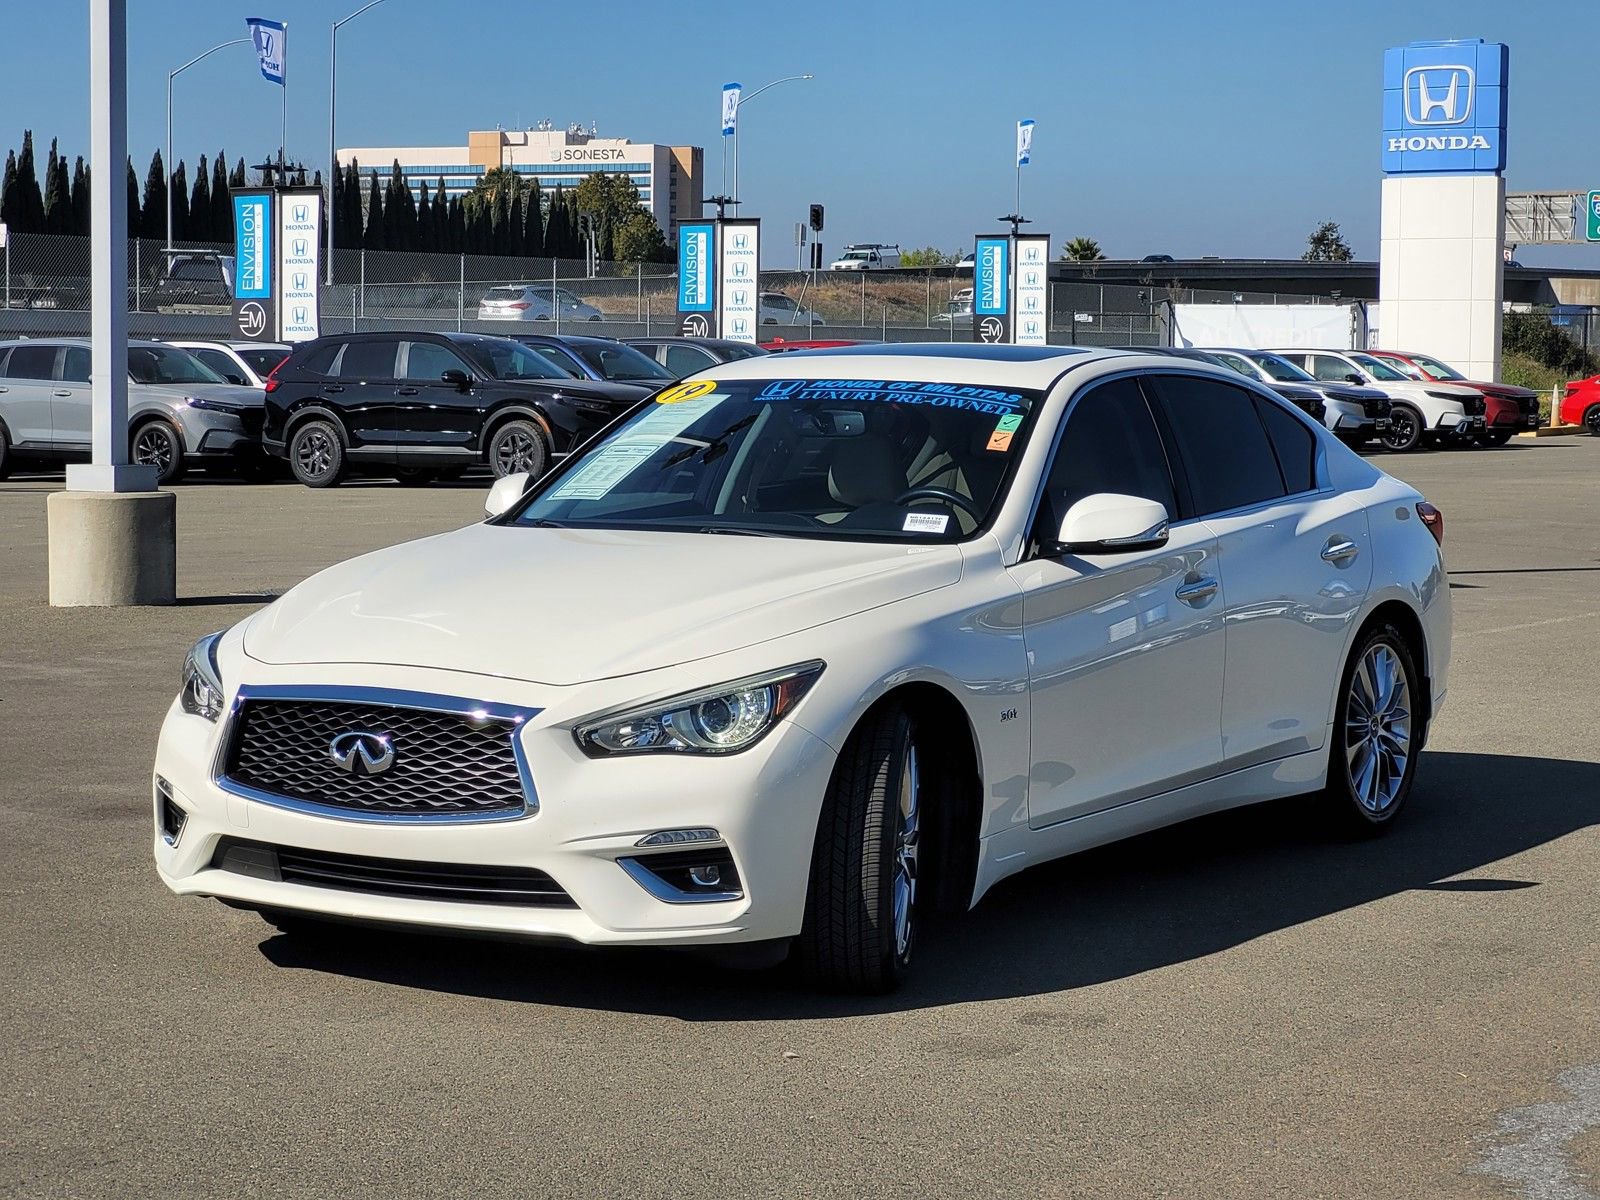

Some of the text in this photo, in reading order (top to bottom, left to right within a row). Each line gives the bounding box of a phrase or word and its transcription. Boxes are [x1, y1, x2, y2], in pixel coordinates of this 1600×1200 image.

[564, 149, 625, 160] SONESTA
[1388, 134, 1490, 152] HONDA
[242, 204, 256, 290] ENVISION
[685, 232, 698, 304] ENVISION
[982, 246, 994, 309] ENVISION
[662, 384, 708, 400] 19
[809, 380, 1023, 402] HONDA OF MILPITAS
[798, 391, 1012, 415] LUXURY PRE-OWNED
